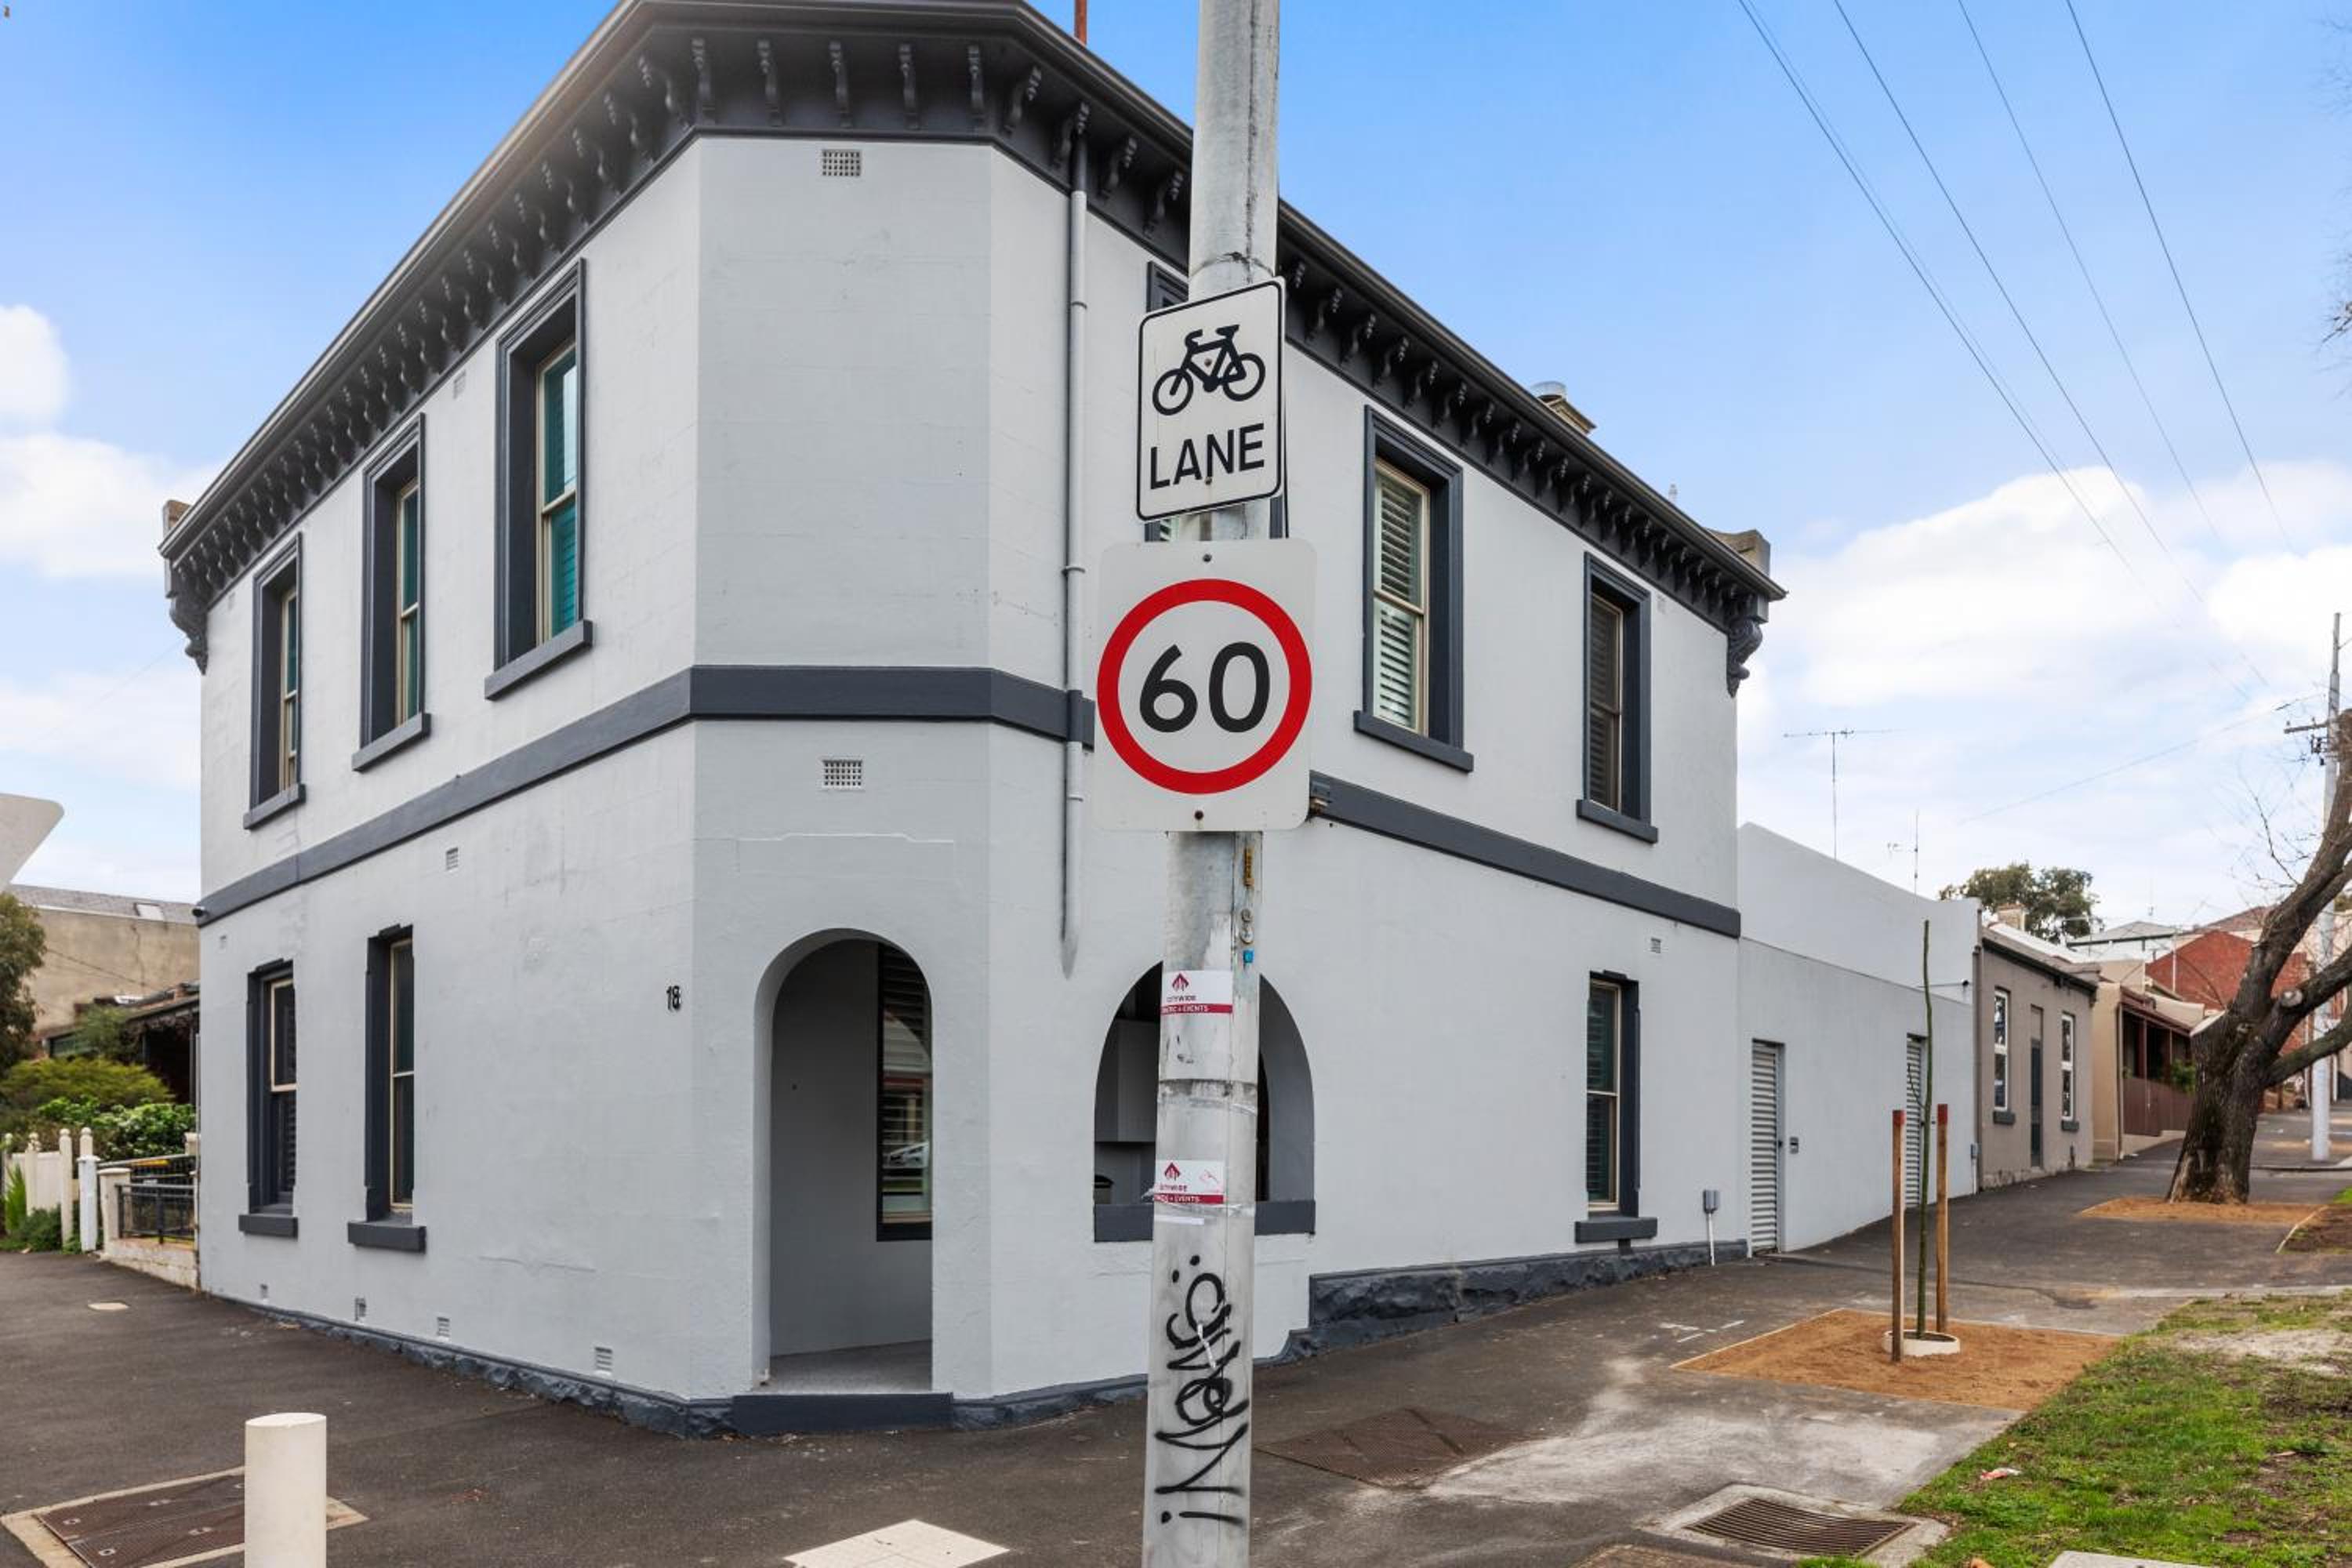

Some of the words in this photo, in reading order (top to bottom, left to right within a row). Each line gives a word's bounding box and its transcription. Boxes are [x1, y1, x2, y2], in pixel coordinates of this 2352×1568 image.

[1149, 422, 1265, 490] LANE
[1139, 641, 1271, 733] 60
[666, 985, 681, 1011] 18
